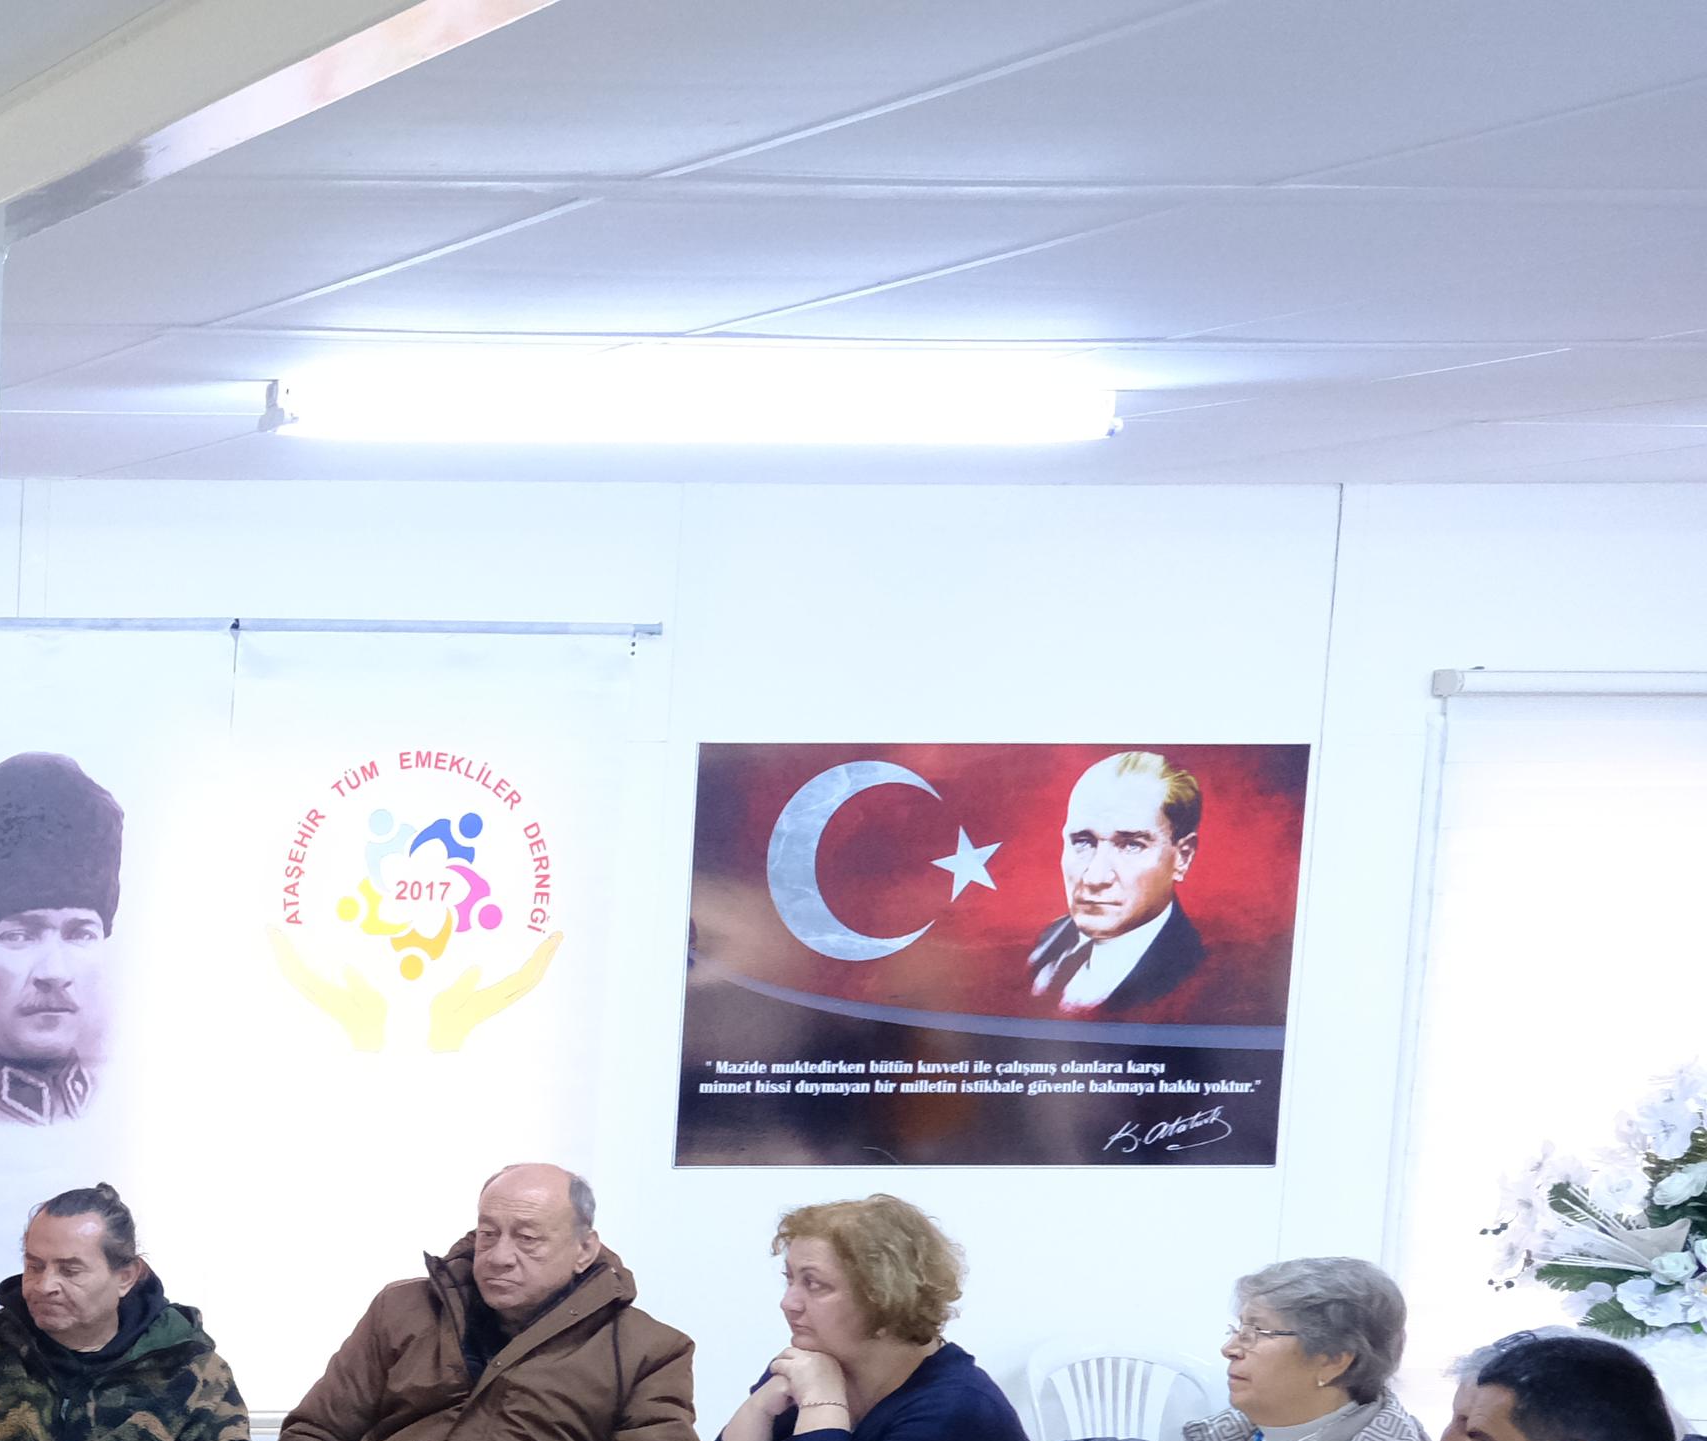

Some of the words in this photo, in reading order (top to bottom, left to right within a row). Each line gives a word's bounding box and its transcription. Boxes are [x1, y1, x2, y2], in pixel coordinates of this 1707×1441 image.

[283, 807, 327, 925] ATAŞEHİR
[330, 760, 380, 798] TÜM
[398, 750, 523, 811] EMEKLİLER
[522, 821, 551, 935] DERNEĞİ
[394, 880, 452, 902] 2017
[715, 1060, 767, 1074] Mazide
[771, 1060, 865, 1074] muktedirken
[869, 1060, 913, 1074] bütün
[917, 1060, 969, 1074] kuvveti
[973, 1060, 992, 1074] ile
[995, 1060, 1057, 1076] çalışmış
[1061, 1060, 1123, 1074] olanlara
[1126, 1060, 1166, 1077] karşı
[699, 1080, 751, 1094] minnet
[794, 1080, 870, 1096] duymayan
[874, 1080, 897, 1094] bir
[899, 1080, 957, 1094] milletin
[960, 1080, 1025, 1094] istikbale
[1027, 1080, 1085, 1096] güvenle
[1089, 1080, 1155, 1096] bakmaya
[1158, 1080, 1200, 1094] hakkı
